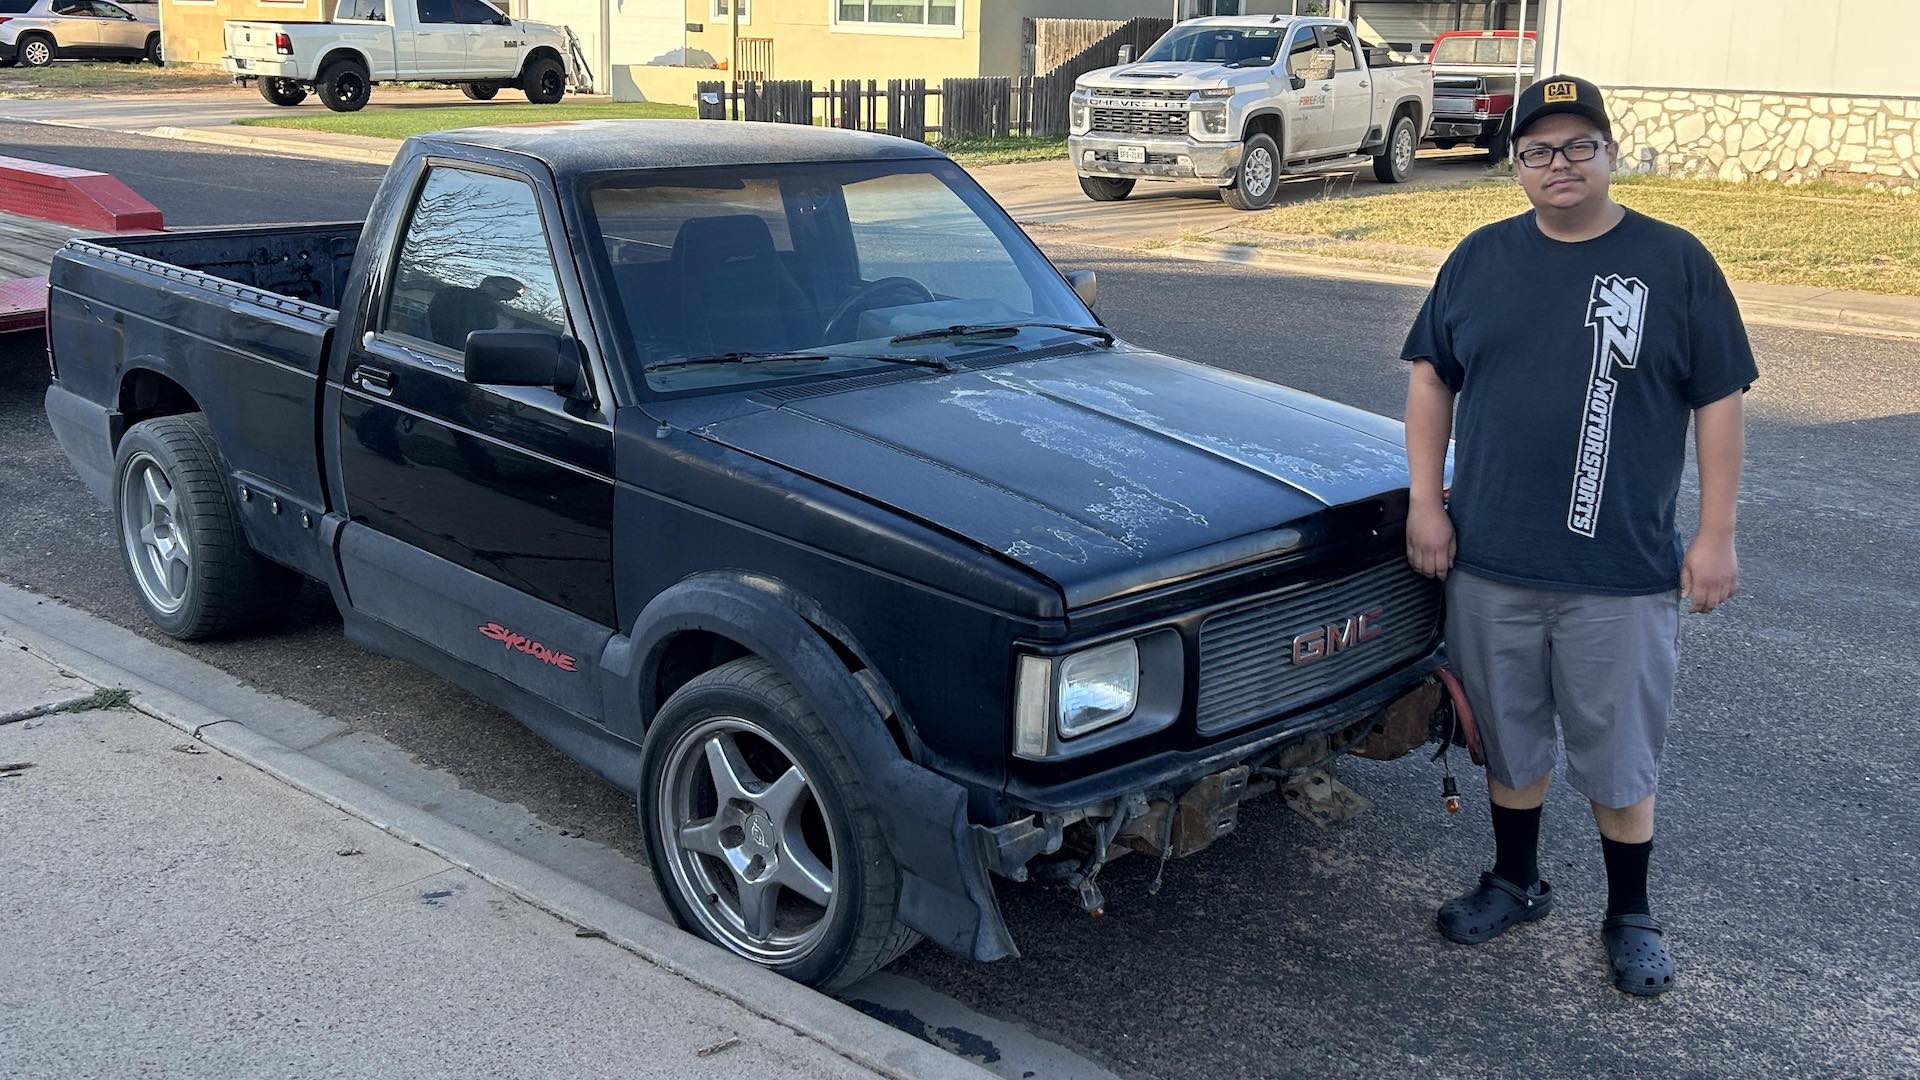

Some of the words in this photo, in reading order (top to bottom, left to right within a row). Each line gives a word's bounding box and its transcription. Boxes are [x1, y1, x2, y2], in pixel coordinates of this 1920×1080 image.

[1089, 98, 1188, 109] CHEVROLET
[1549, 84, 1572, 96] CAT
[1572, 378, 1612, 532] MOTORSPORTS
[1293, 605, 1384, 665] GMC
